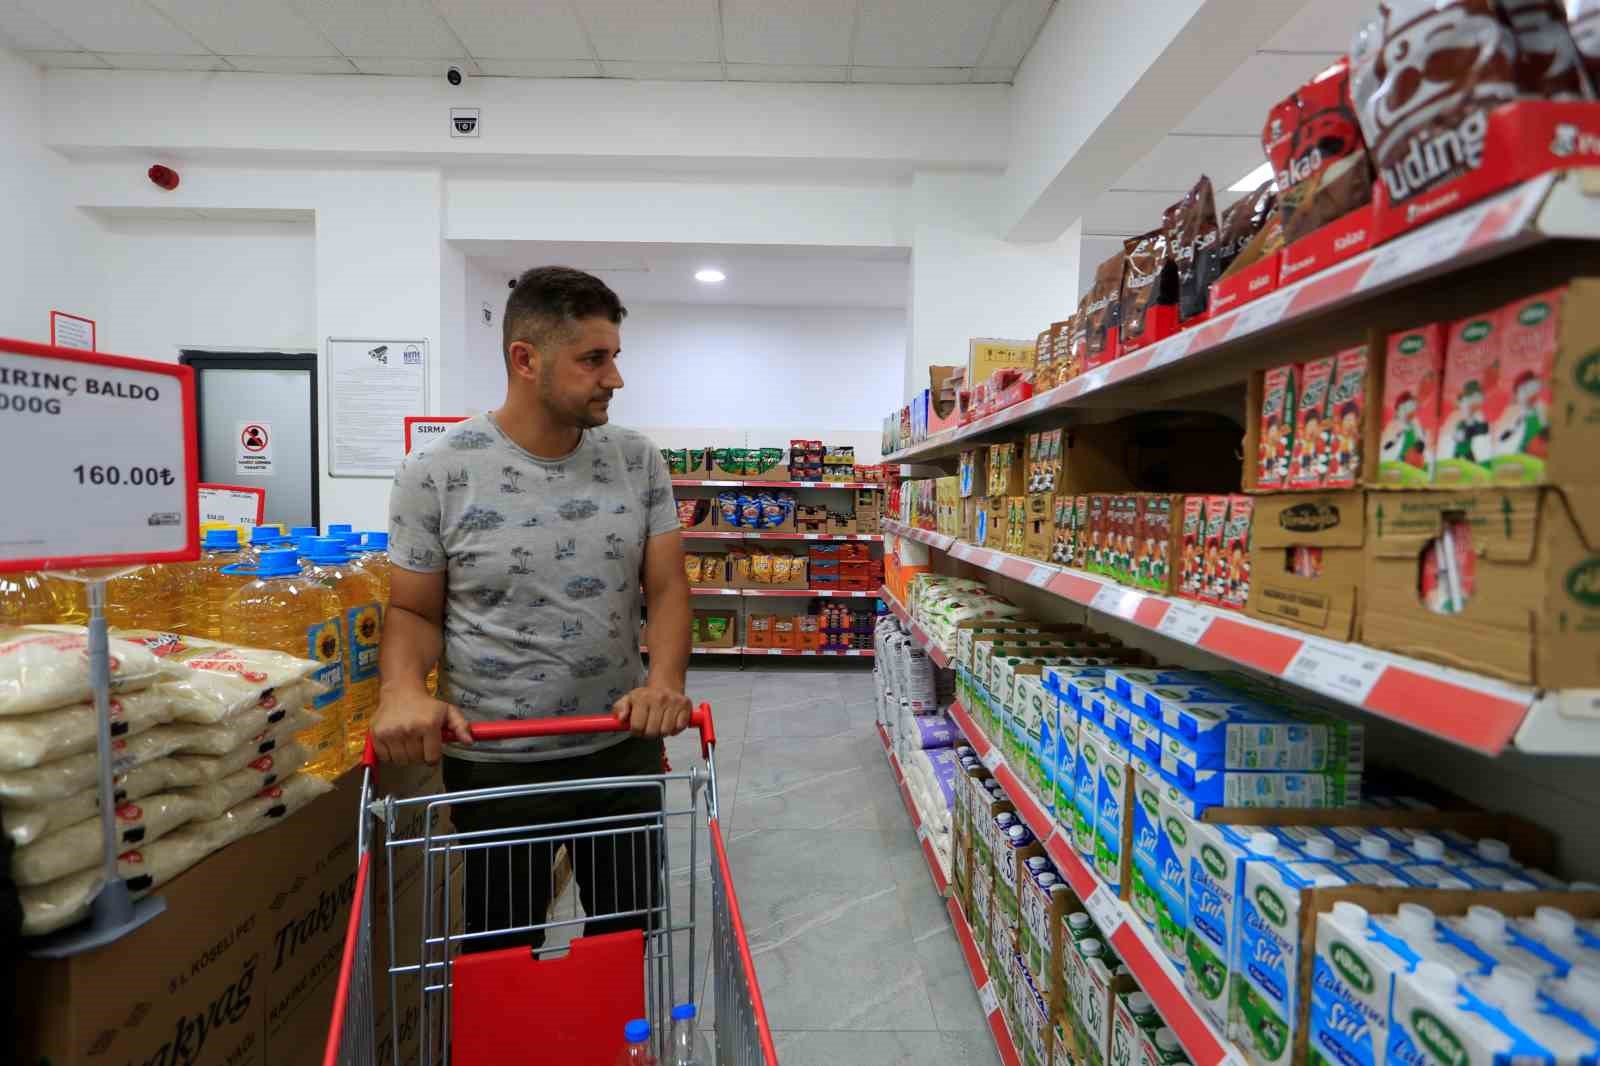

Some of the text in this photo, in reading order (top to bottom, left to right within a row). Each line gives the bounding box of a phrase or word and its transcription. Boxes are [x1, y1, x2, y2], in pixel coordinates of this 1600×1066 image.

[86, 377, 160, 401] BALDO
[417, 425, 447, 433] SIRMA
[73, 464, 176, 486] 160.00₺
